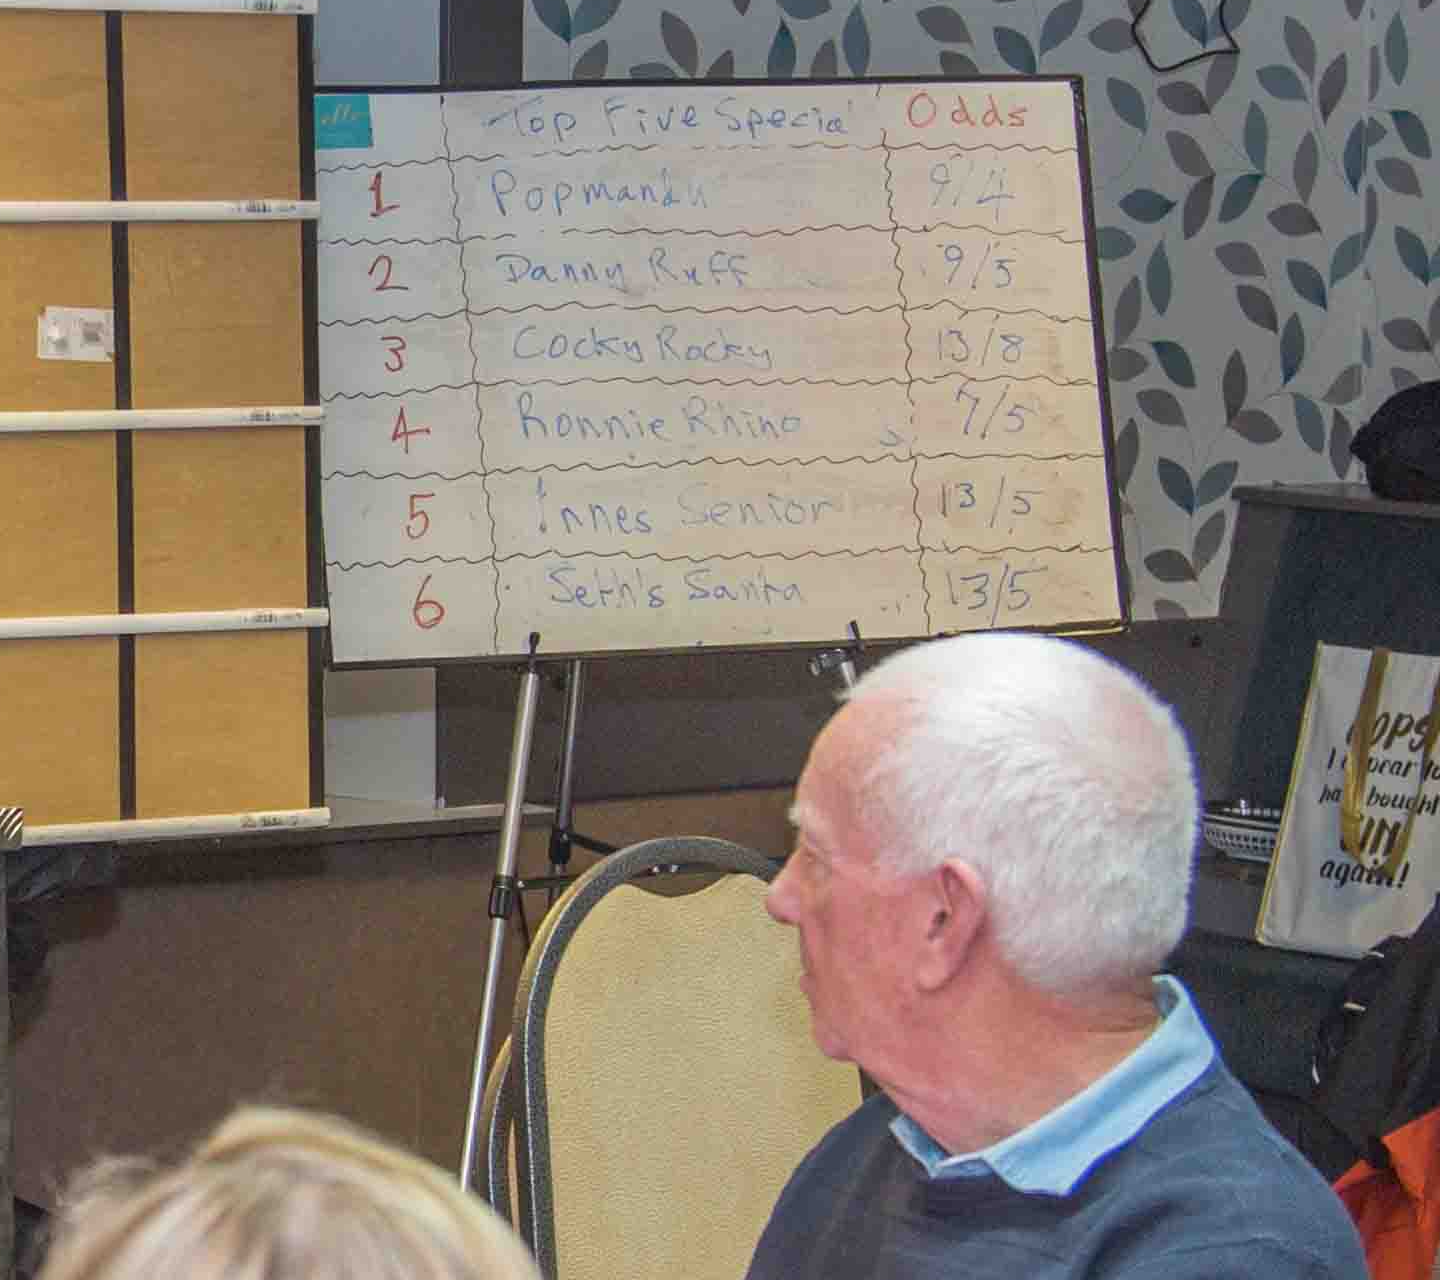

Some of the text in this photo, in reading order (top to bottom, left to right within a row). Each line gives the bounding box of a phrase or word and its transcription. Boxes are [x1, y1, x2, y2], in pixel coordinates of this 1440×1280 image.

[482, 94, 577, 142] Top
[601, 97, 701, 137] Five
[906, 91, 1029, 129] Odds
[369, 170, 401, 217] 1
[367, 254, 409, 292] 2
[495, 252, 626, 292] Danny
[380, 325, 775, 373] 3 Cocky Rocky
[936, 322, 1024, 368] 13/8
[390, 406, 432, 455] 4
[681, 394, 801, 441] Rhino
[405, 492, 436, 540] 5
[940, 474, 1043, 528] 13/5
[411, 574, 446, 629] 6
[946, 562, 1048, 628] 13/5
